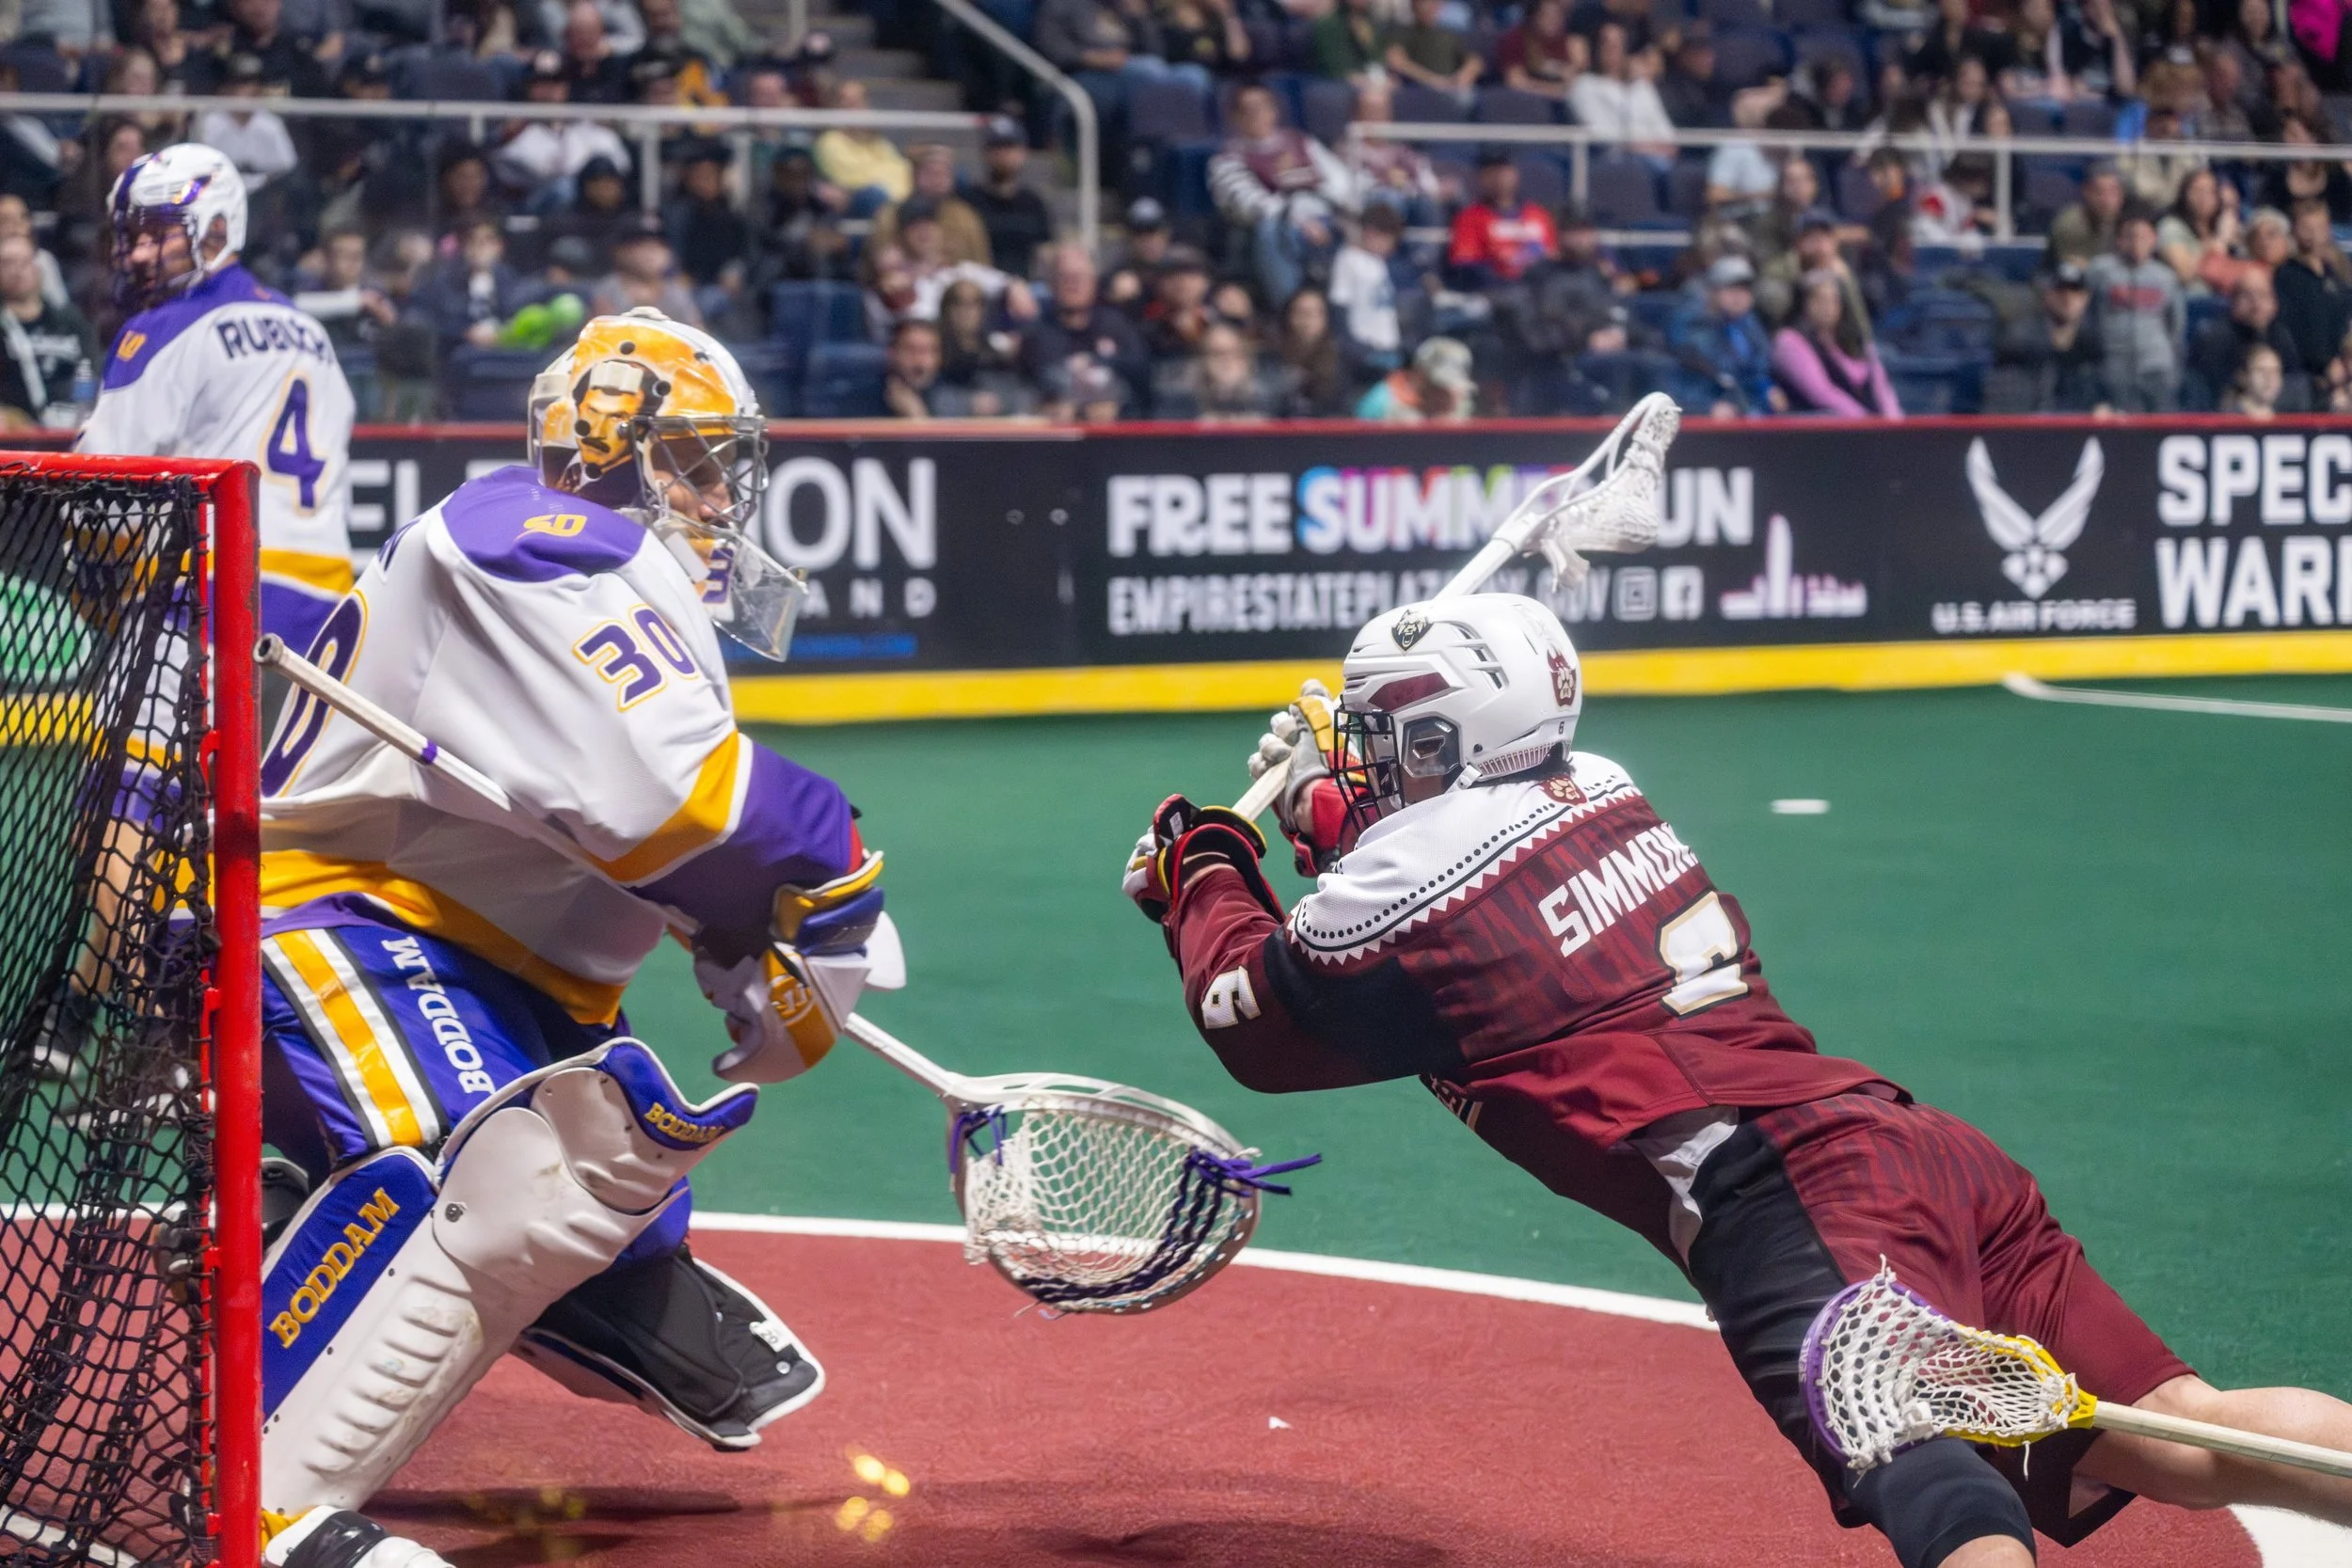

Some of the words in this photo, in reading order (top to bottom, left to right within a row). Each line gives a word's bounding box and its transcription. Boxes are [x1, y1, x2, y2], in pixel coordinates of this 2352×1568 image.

[259, 371, 327, 517] 4
[1107, 473, 1294, 556] FREE
[573, 603, 700, 712] 30
[1984, 602, 2036, 631] AIR
[2040, 599, 2137, 629] FORCE
[1558, 721, 1565, 735] 6
[1538, 821, 1699, 958] SIMMON
[381, 936, 497, 1096] BODDAM
[267, 1187, 401, 1350] BODDAM
